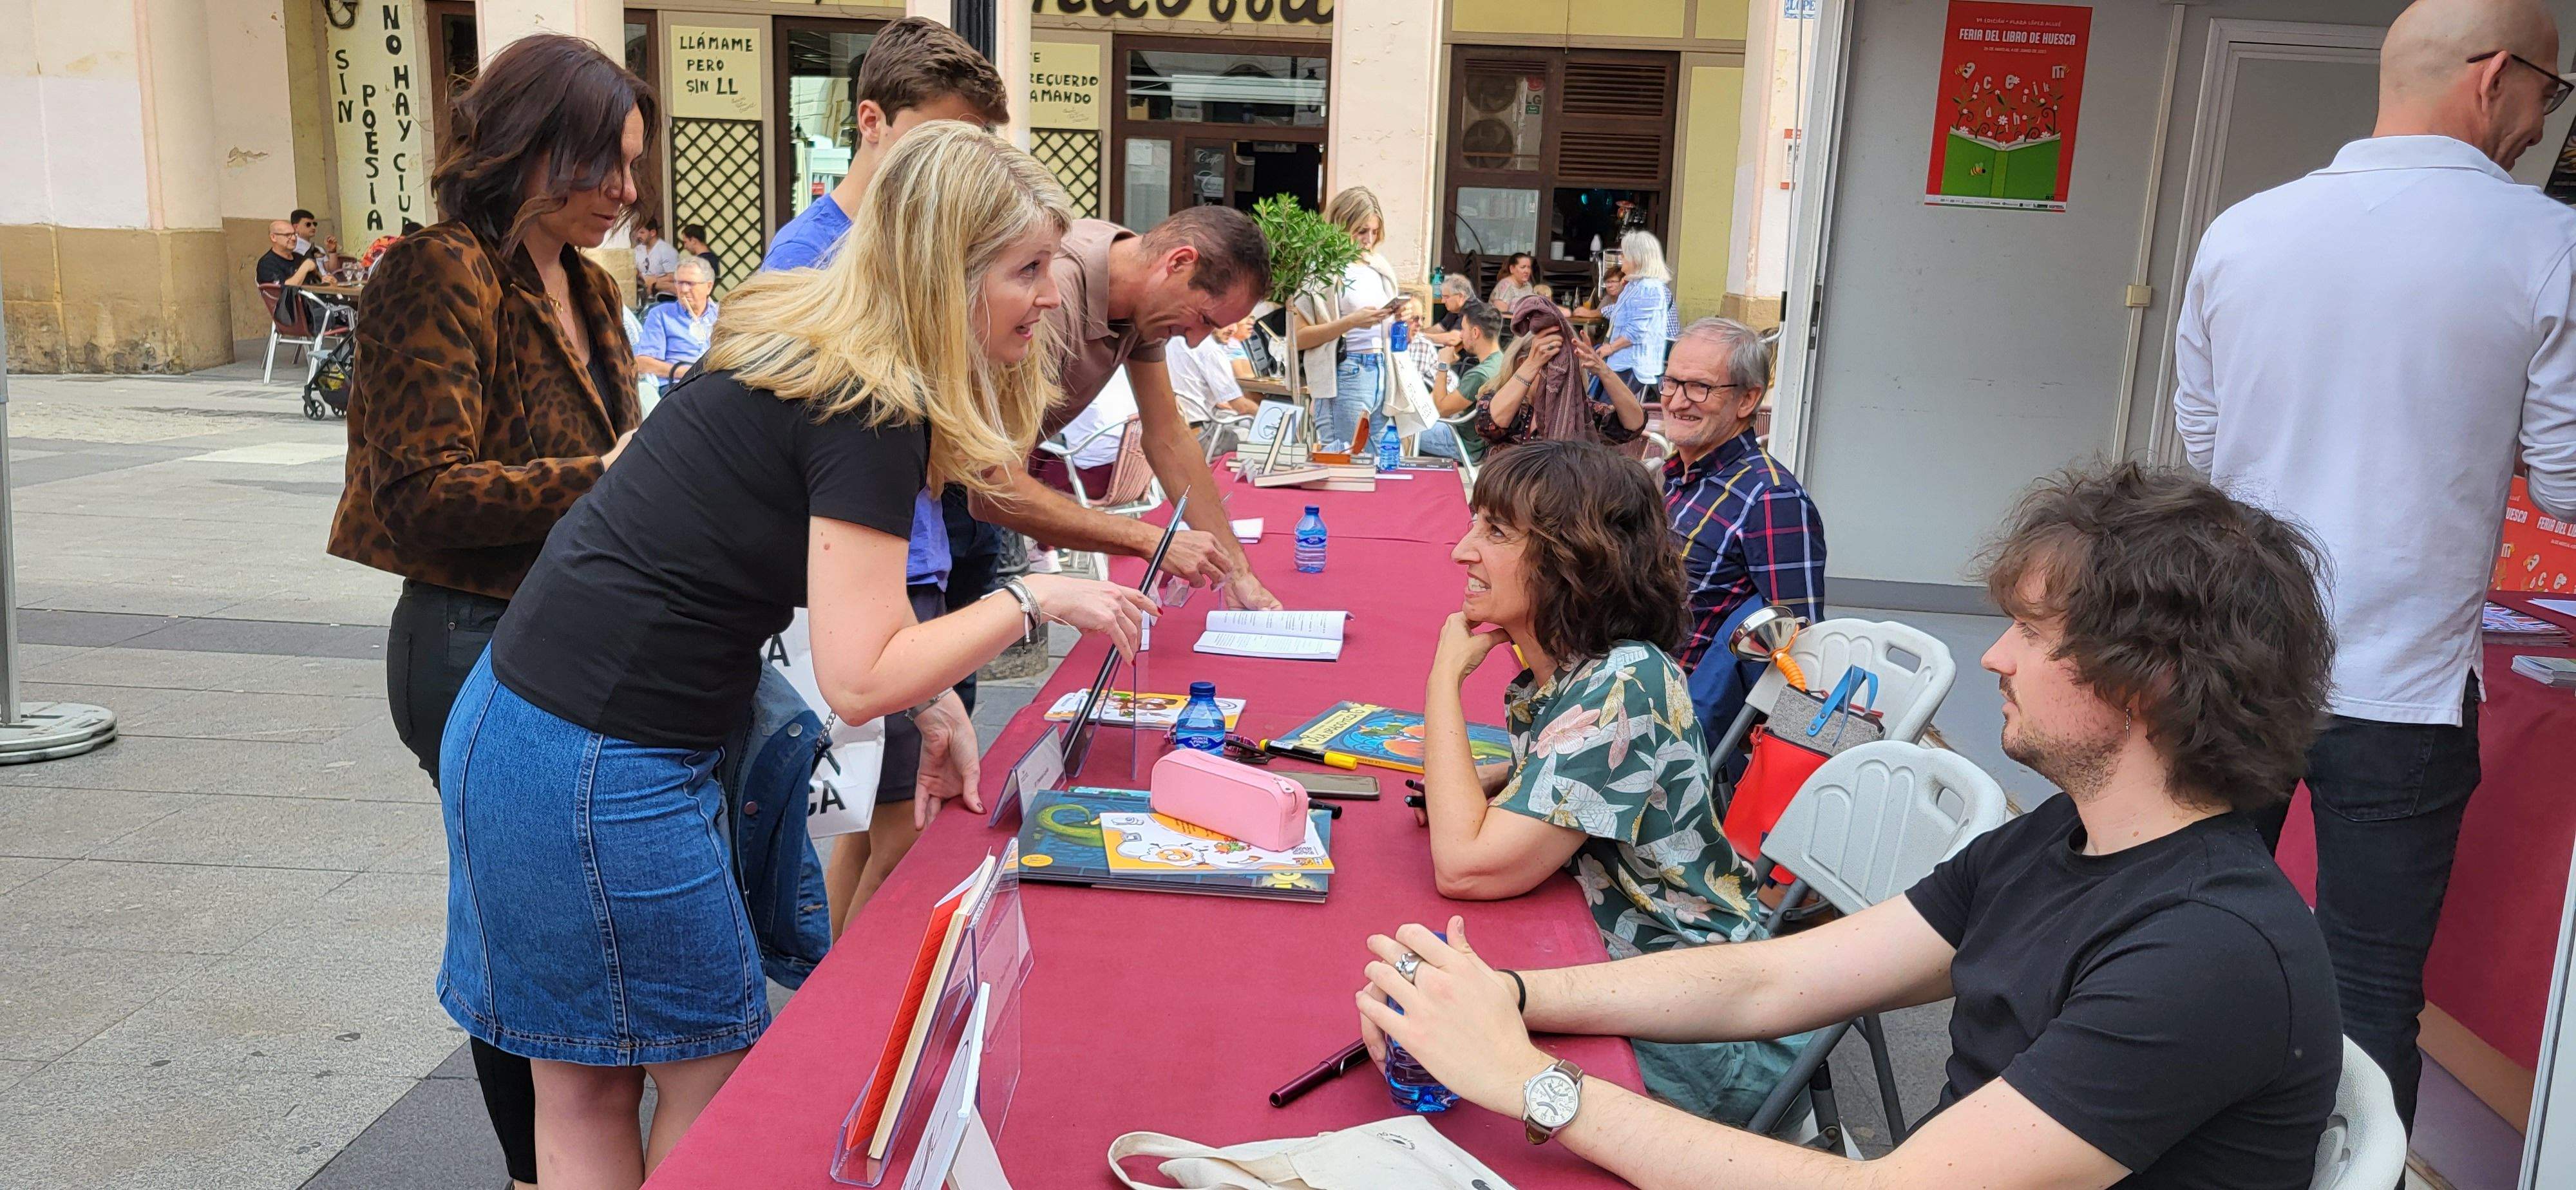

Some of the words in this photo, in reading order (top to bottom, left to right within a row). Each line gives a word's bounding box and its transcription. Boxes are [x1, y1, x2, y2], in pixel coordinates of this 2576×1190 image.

[679, 32, 753, 52] LLÁMAME
[1959, 28, 1983, 41] FERIA
[1985, 30, 2000, 42] DEL
[2002, 31, 2027, 43] LIBRO
[2029, 32, 2041, 44] DE
[2042, 33, 2076, 46] HUESCA
[383, 5, 402, 55] NO
[393, 65, 412, 142] HAY
[687, 59, 724, 72] PERO
[335, 49, 354, 123] SIN
[686, 78, 709, 94] SIN
[716, 77, 739, 95] LL
[1030, 89, 1092, 104] AMANDO
[1526, 94, 1542, 105] LG
[362, 84, 383, 231] POESIA
[2505, 507, 2528, 524] UESCA
[2537, 516, 2556, 532] FERIA
[2555, 520, 2568, 535] DEL
